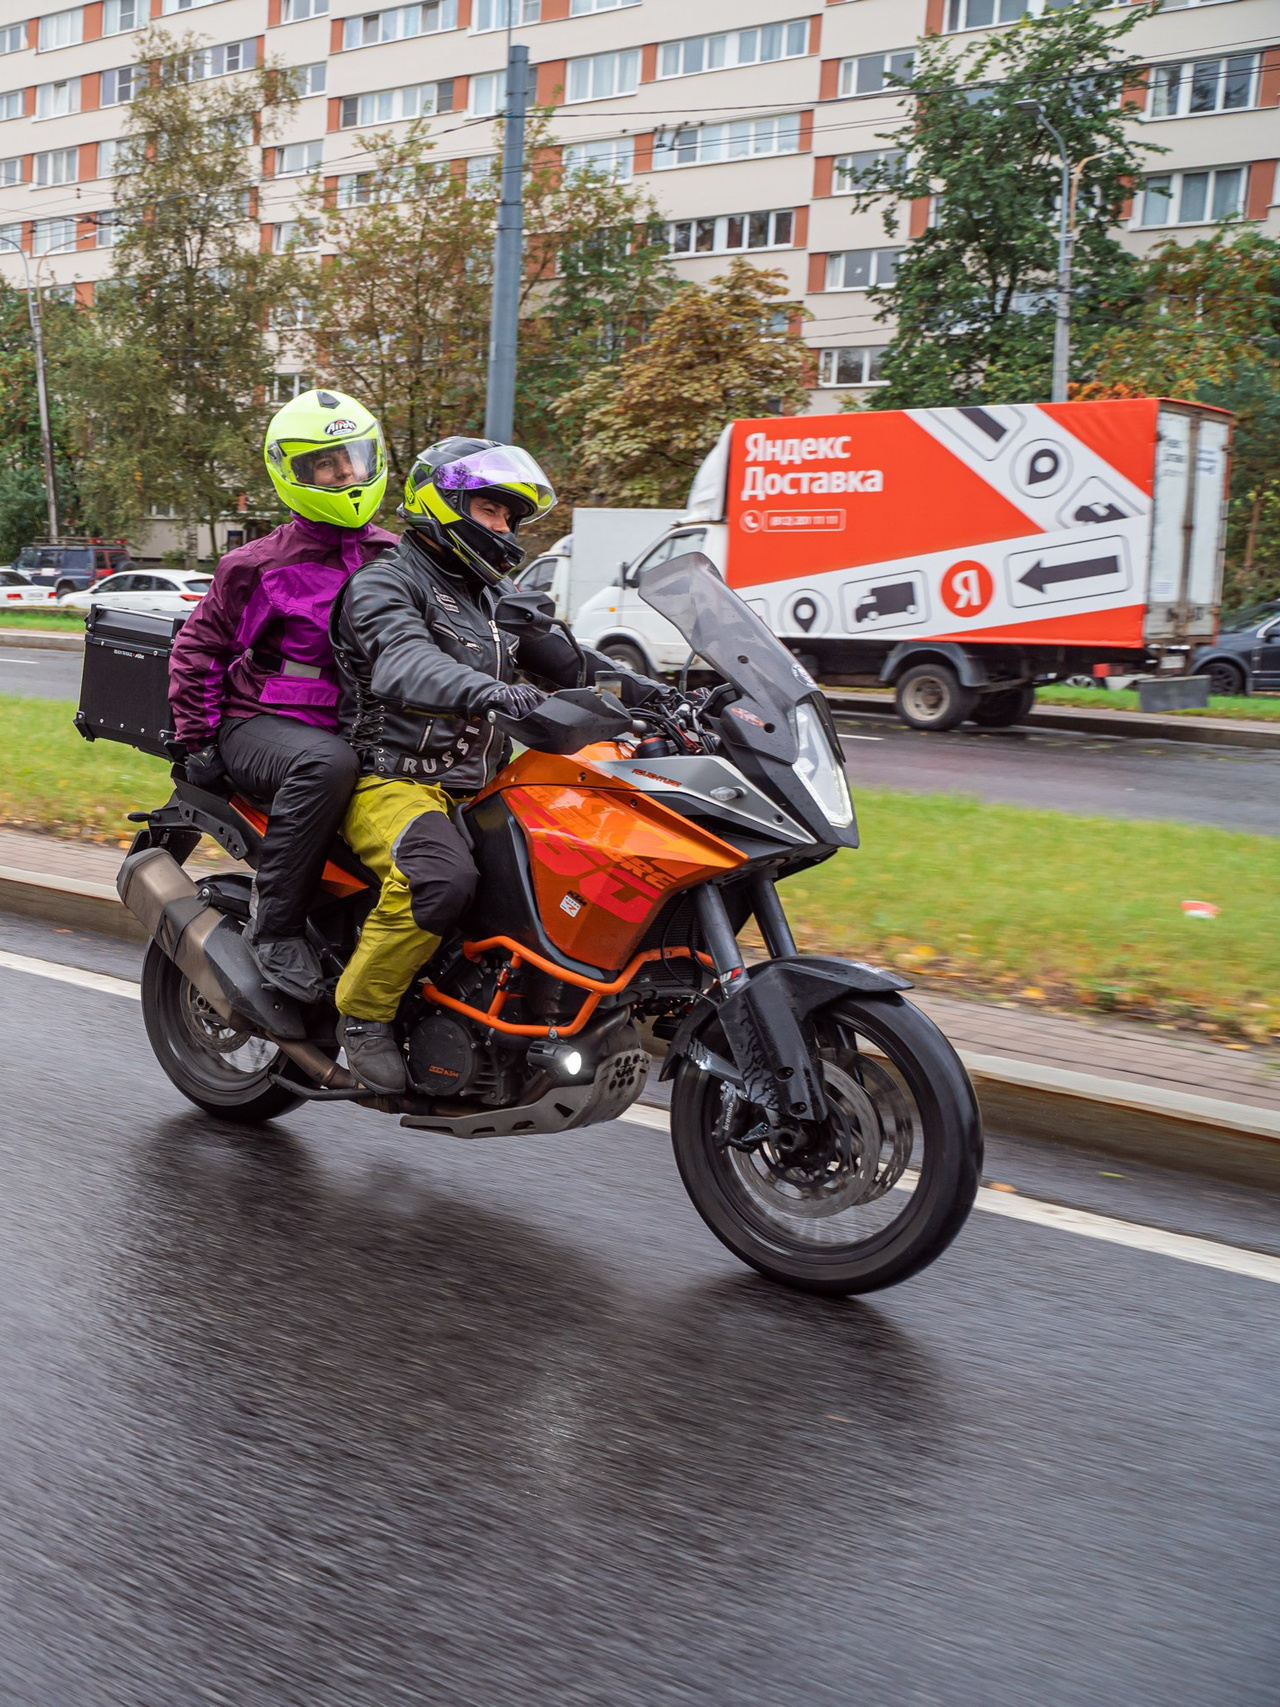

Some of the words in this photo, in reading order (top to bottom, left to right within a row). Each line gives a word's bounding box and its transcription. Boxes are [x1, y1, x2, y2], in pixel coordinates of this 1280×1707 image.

[326, 420, 357, 434] Airoh
[744, 432, 852, 465] Яндекс
[740, 466, 884, 501] Доставка
[952, 569, 982, 609] Я
[402, 725, 480, 774] RUSSI
[723, 1102, 734, 1131] brembo
